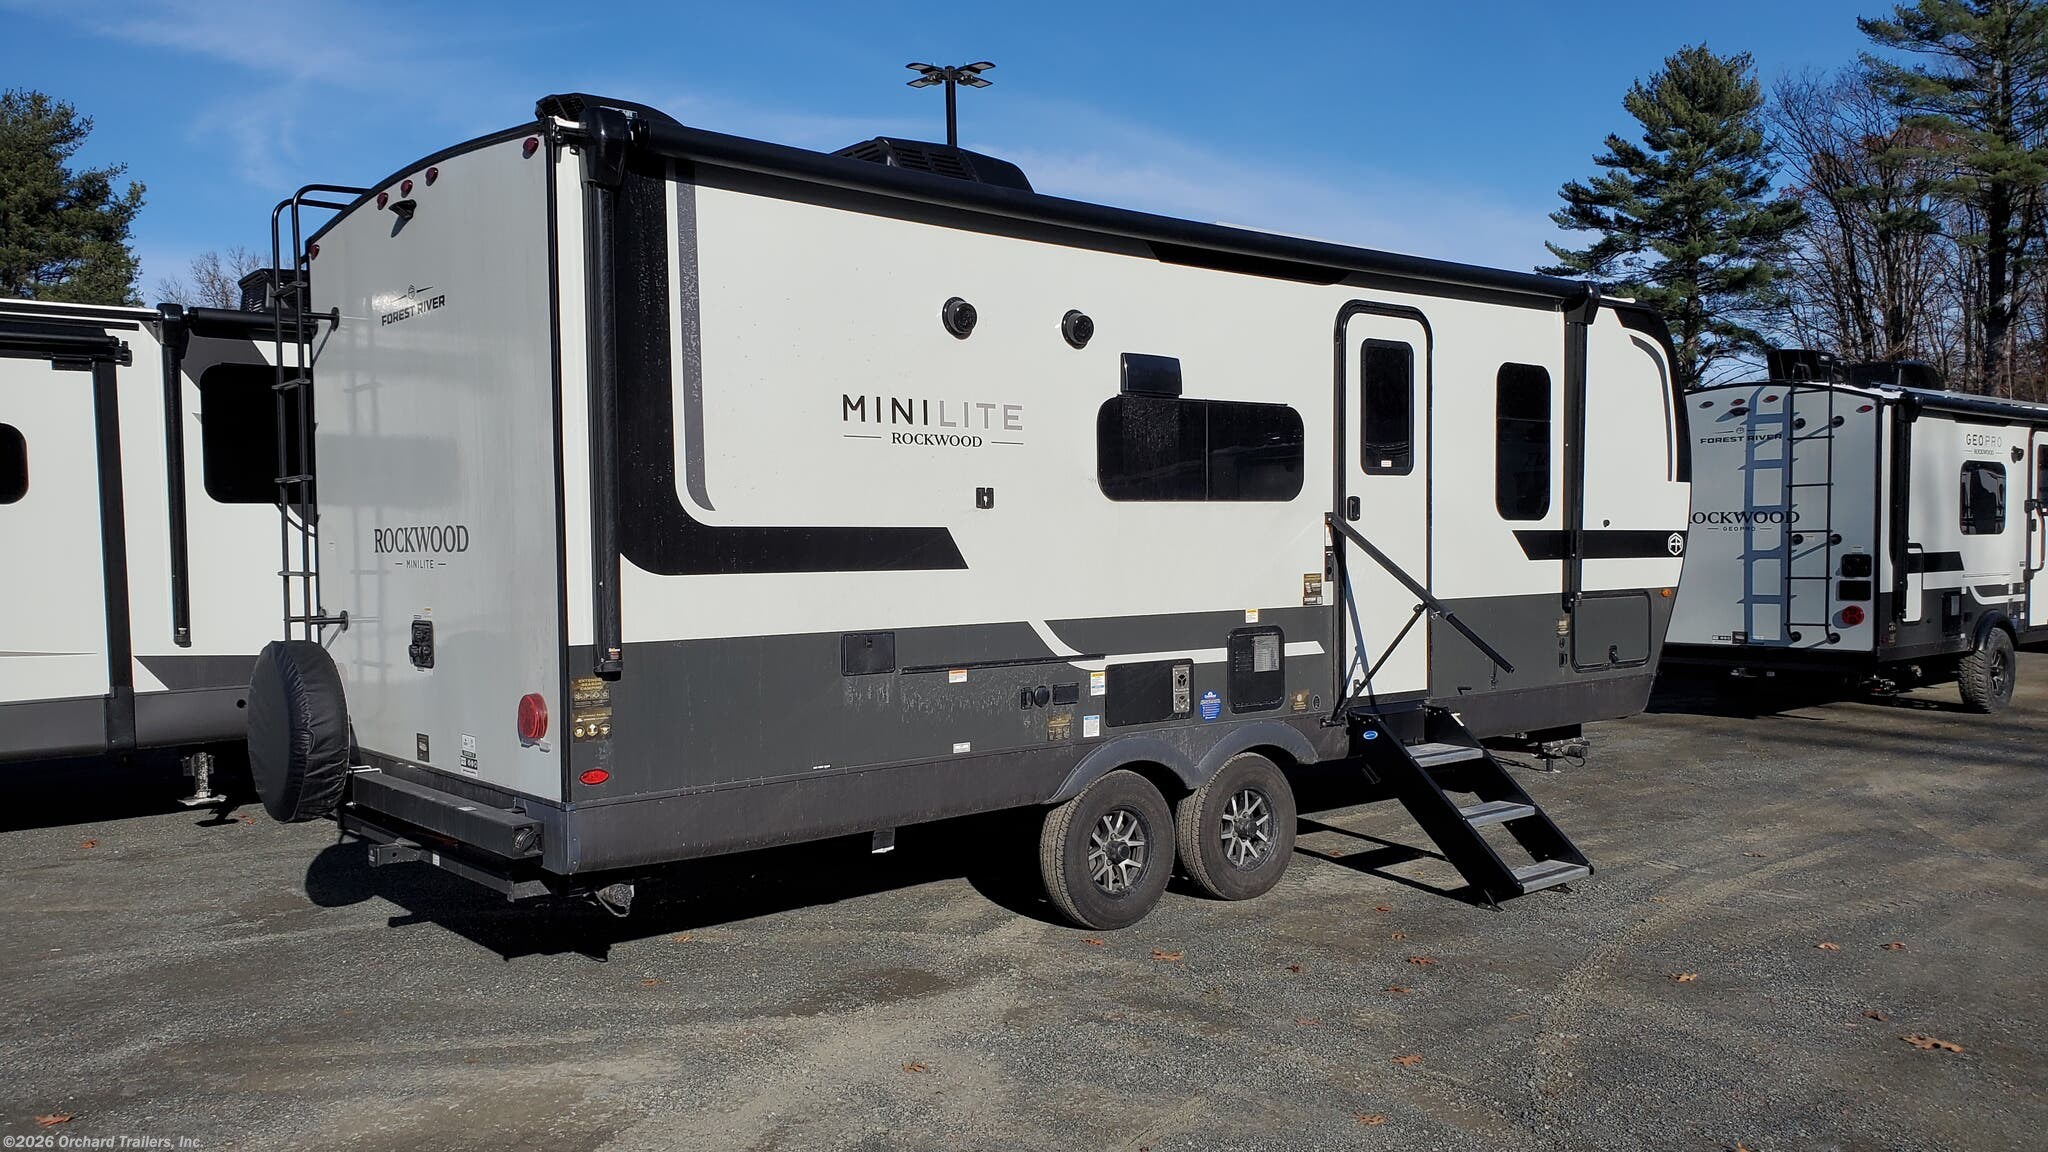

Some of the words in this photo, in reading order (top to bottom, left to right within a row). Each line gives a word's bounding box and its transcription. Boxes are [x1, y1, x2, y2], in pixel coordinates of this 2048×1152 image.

[381, 305, 416, 326] FOREST
[417, 295, 446, 315] RIVER
[842, 393, 1023, 431] MINILITE
[891, 432, 983, 448] ROCKWOOD
[1700, 435, 1745, 444] FOREST
[1747, 433, 1782, 442] RIVER
[1689, 510, 1801, 525] OCKWOOD
[374, 524, 470, 553] ROCKWOOD
[406, 559, 434, 569] MINILITE
